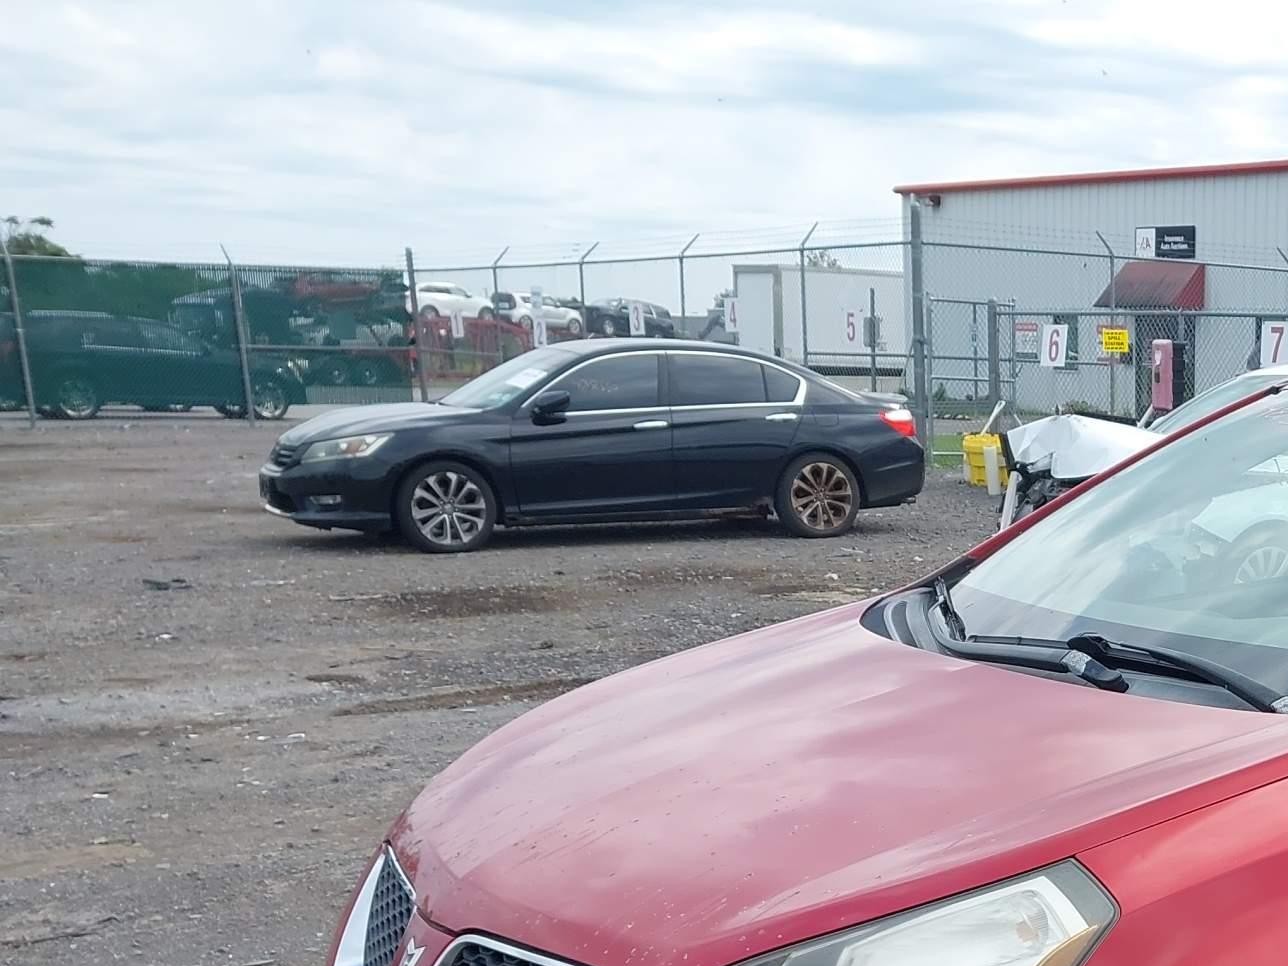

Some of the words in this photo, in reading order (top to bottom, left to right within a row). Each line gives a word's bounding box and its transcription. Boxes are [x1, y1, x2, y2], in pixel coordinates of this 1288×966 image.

[632, 306, 641, 332] 3
[729, 301, 737, 328] 4
[846, 312, 856, 342] 5
[536, 320, 545, 345] 2
[1048, 328, 1060, 362] 6
[1270, 326, 1284, 363] 7
